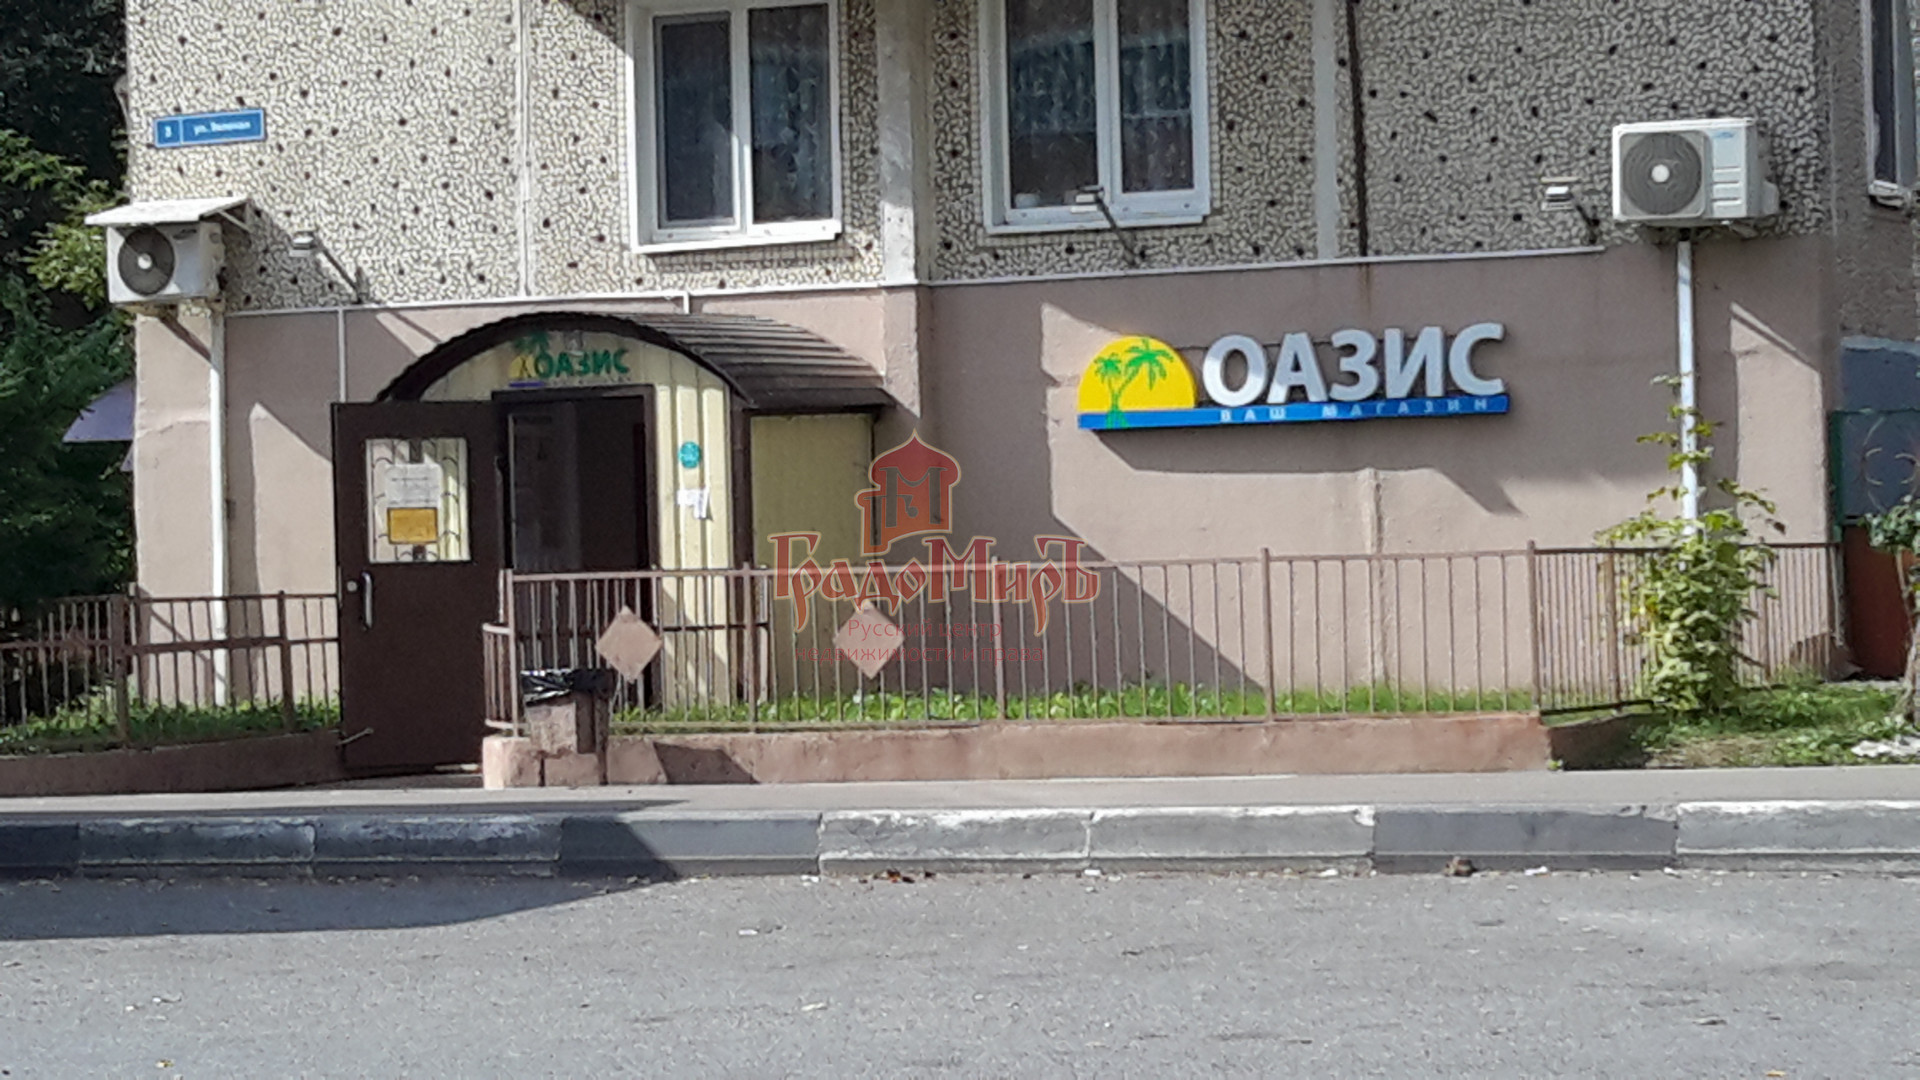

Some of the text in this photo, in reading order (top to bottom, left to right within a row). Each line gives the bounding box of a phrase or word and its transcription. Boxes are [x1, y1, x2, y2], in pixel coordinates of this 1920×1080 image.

[534, 349, 630, 379] ОАЗИС
[1202, 322, 1505, 407] ОАЗИС
[1220, 399, 1488, 422] ВАШ МАГАЗИН
